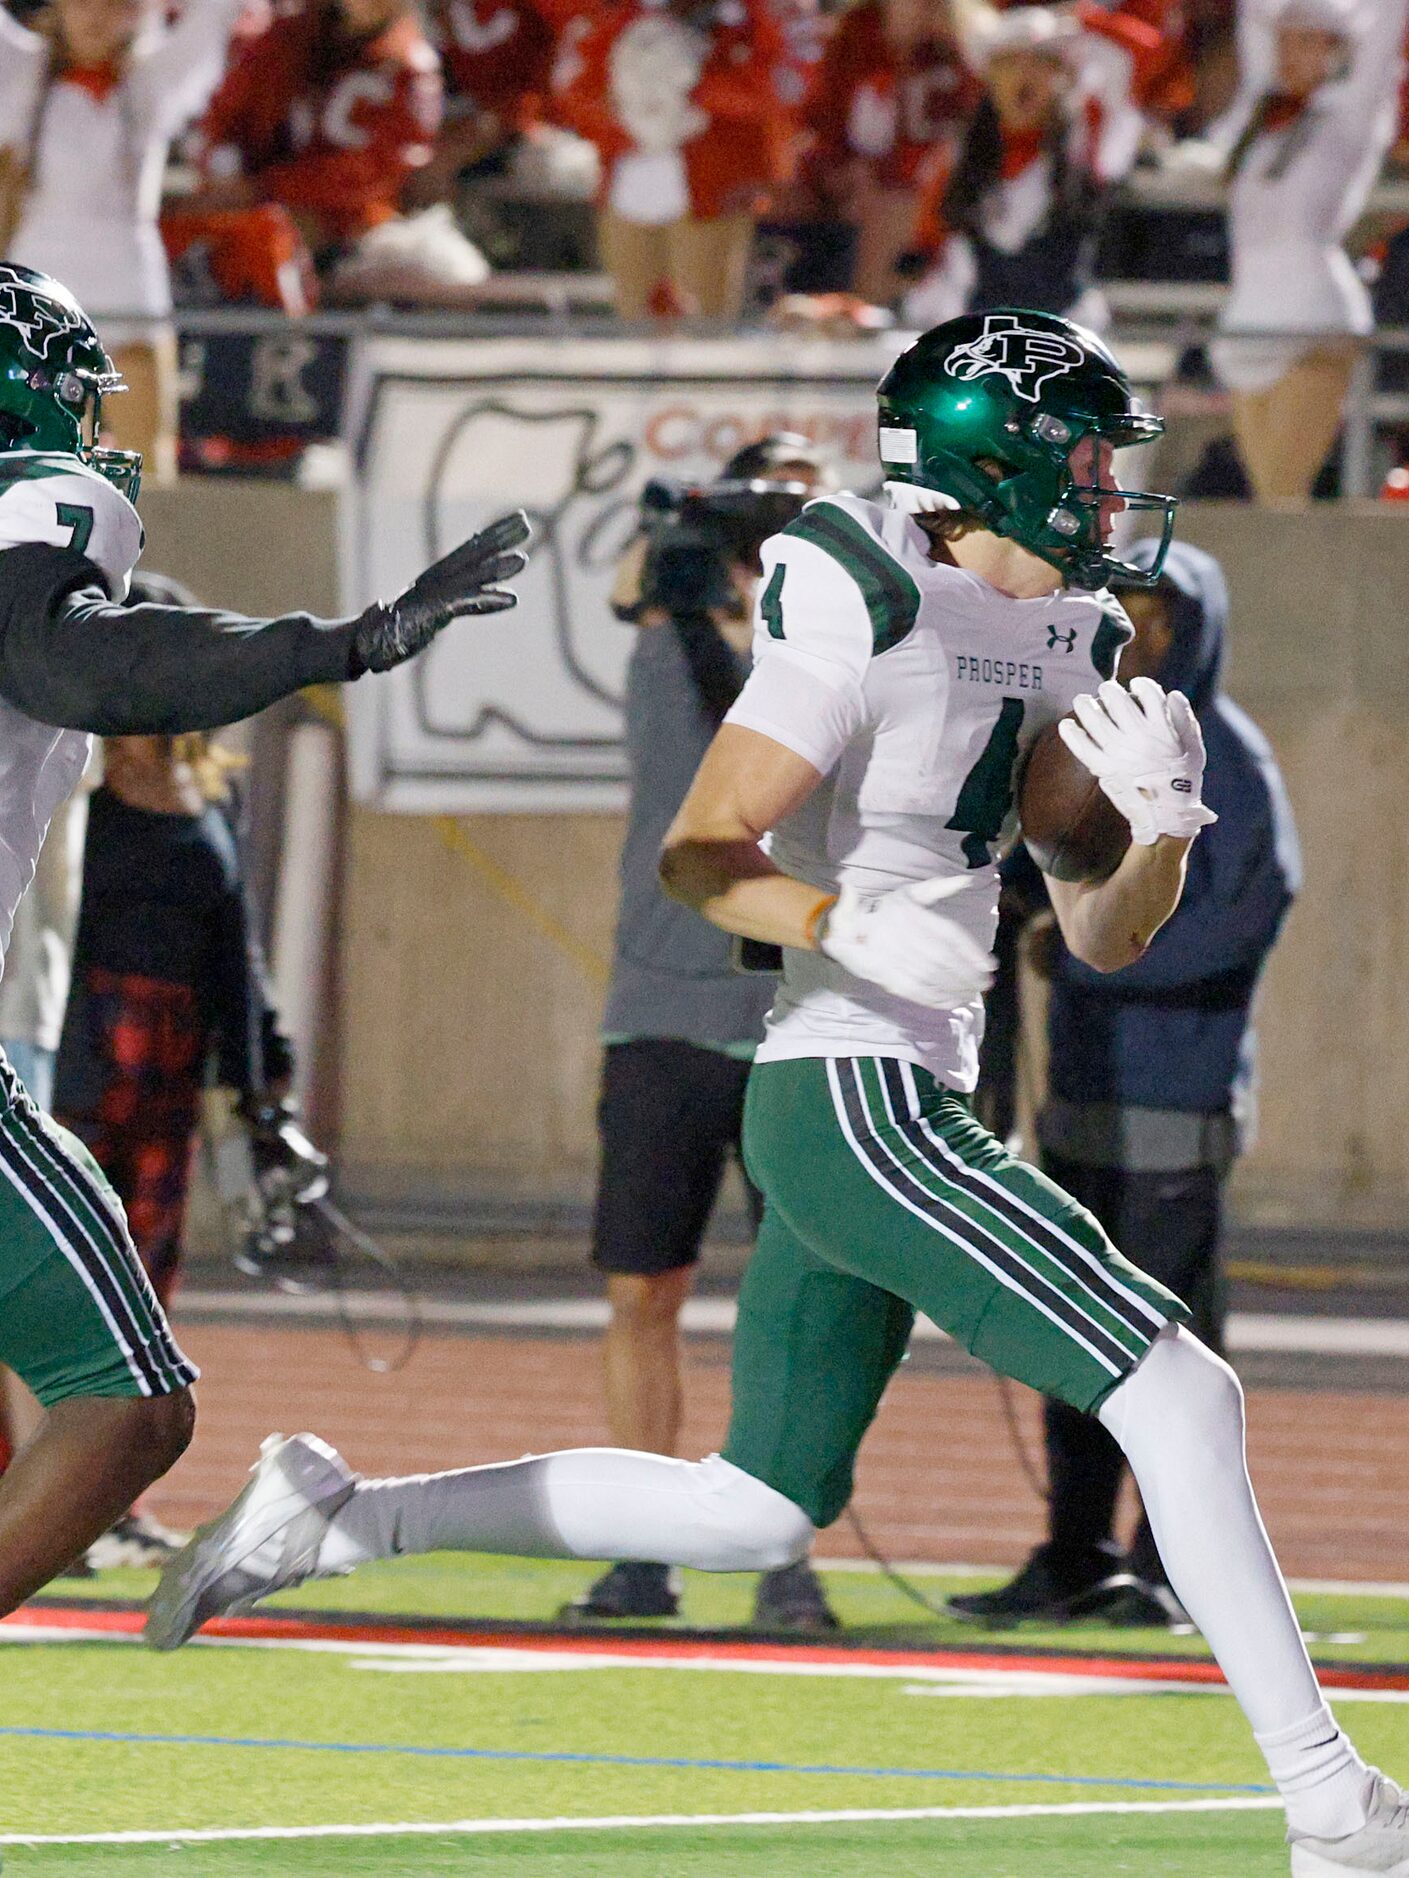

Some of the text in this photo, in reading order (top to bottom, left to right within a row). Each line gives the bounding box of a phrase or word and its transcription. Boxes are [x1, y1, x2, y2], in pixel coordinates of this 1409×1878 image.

[54, 502, 94, 553] 7
[760, 563, 787, 640] 4
[957, 656, 1042, 690] PROSPER
